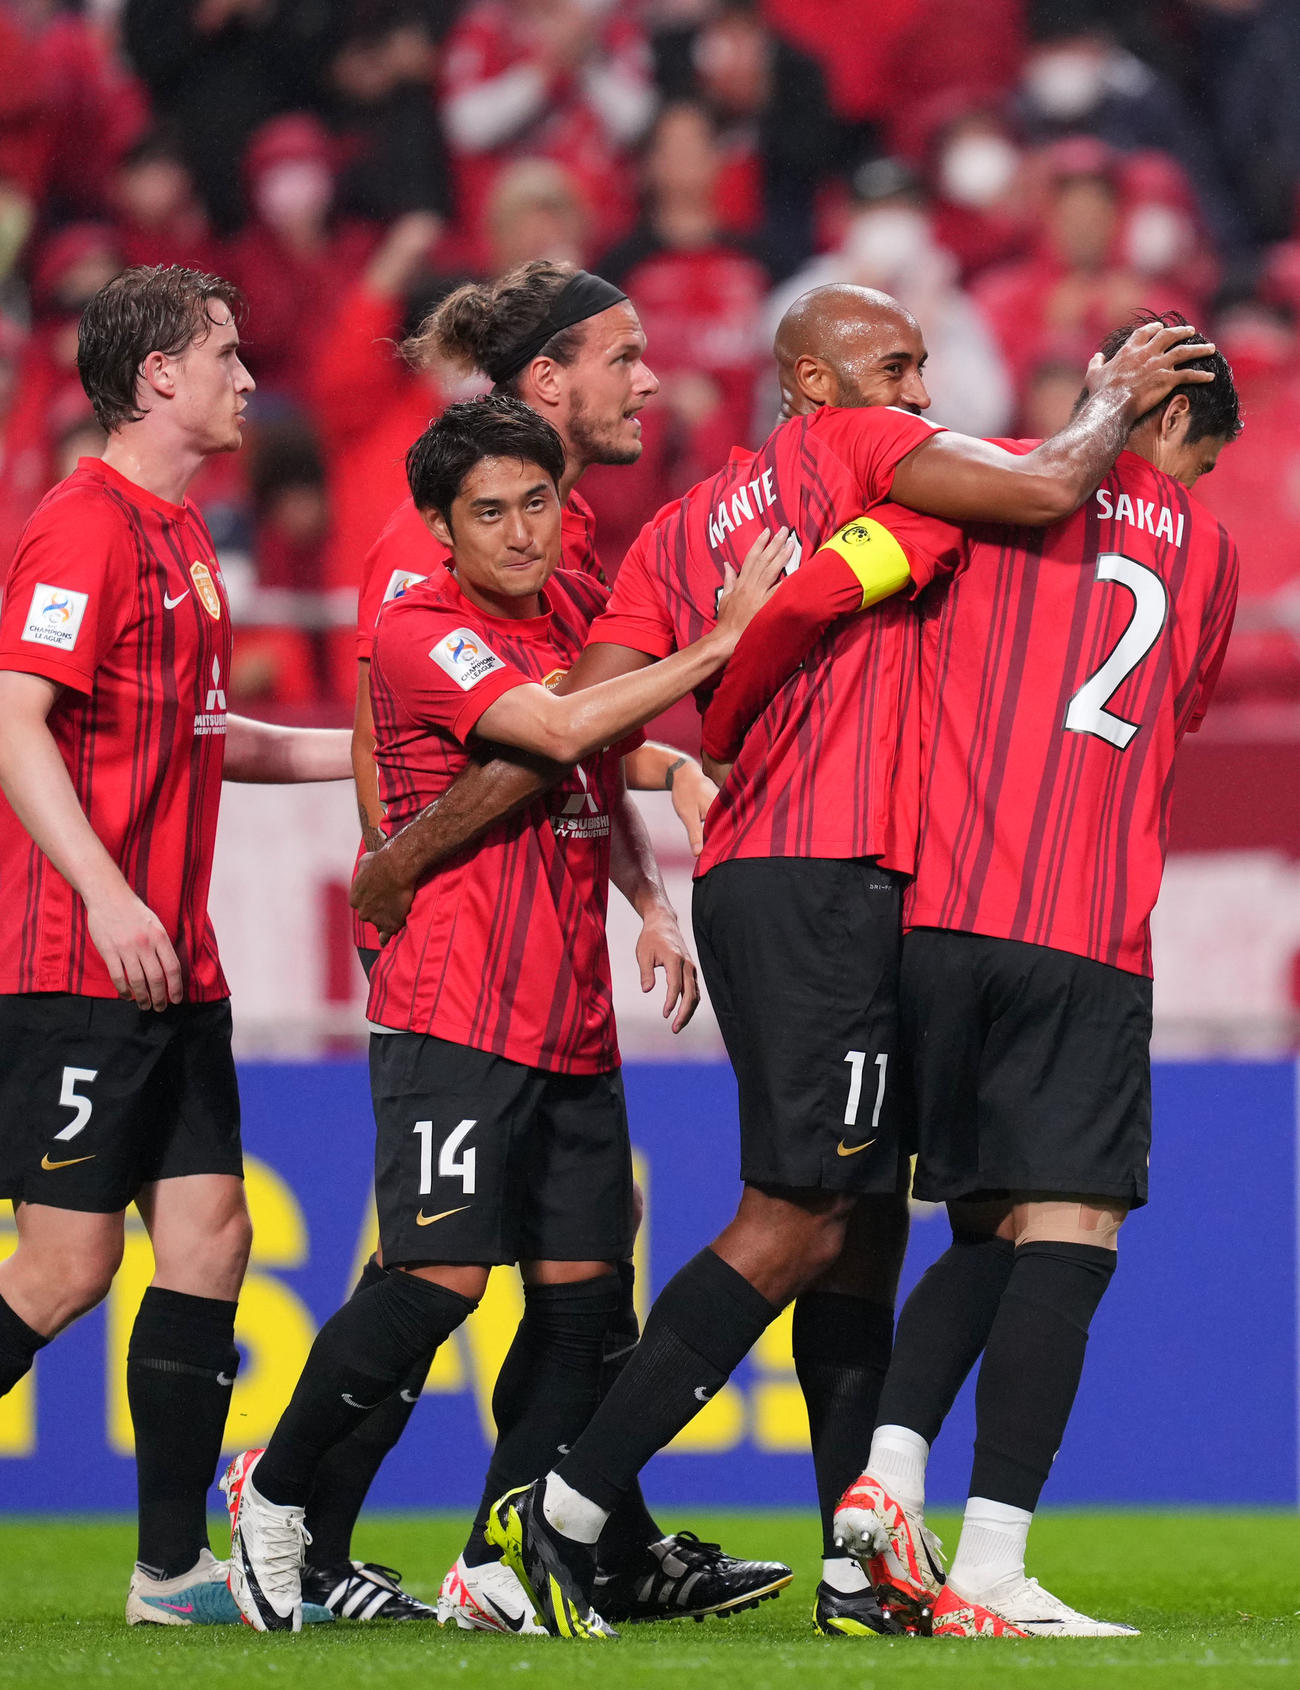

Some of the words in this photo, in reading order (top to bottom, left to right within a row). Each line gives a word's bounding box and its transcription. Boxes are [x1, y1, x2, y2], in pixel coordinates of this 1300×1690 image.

[1095, 488, 1185, 548] SAKAI
[29, 625, 73, 640] CHAMPIONS
[35, 632, 63, 644] LEAGUE
[1061, 552, 1169, 753] 2
[461, 656, 496, 682] CHAMPIONS
[470, 662, 495, 680] LEAGUE
[53, 1065, 98, 1141] 5
[843, 1050, 889, 1128] 11
[412, 1119, 477, 1196] 14
